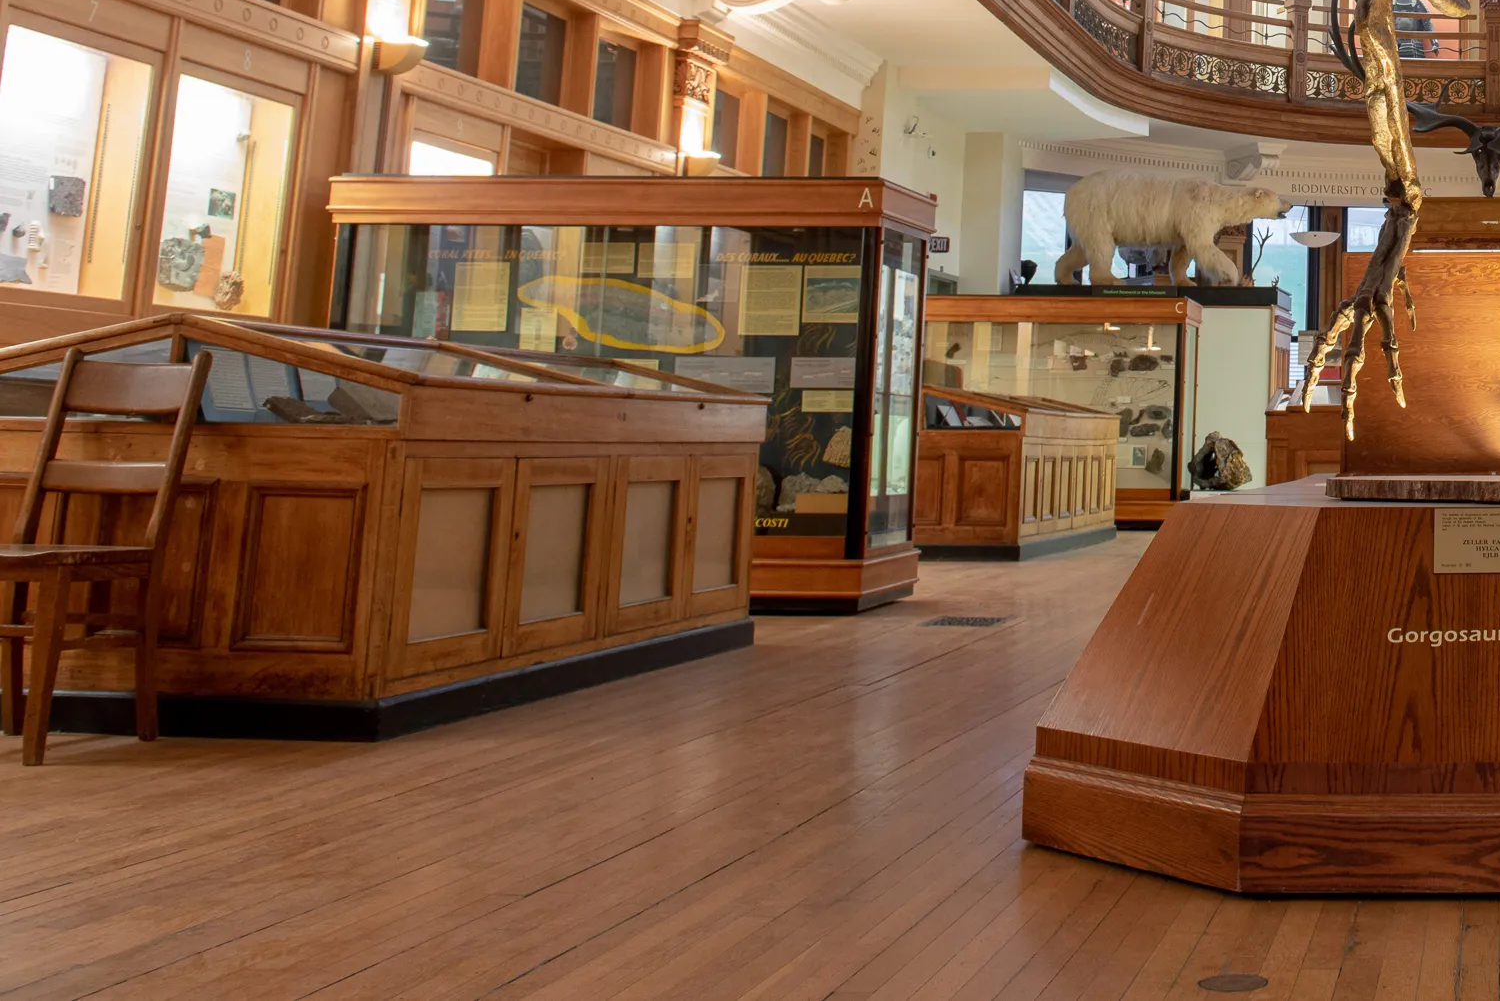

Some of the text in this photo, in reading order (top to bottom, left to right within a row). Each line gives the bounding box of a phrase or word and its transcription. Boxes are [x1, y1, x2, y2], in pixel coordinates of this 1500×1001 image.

[89, 0, 98, 22] 7
[244, 49, 251, 71] 8
[1291, 183, 1385, 196] BIODIVERSITY OF
[858, 187, 874, 208] A
[931, 238, 948, 251] EXIT
[428, 249, 458, 259] CORAL
[504, 249, 518, 259] IN
[716, 252, 737, 262] DES
[792, 253, 809, 262] AU
[808, 253, 856, 264] QUEBEC?
[1175, 301, 1184, 314] C
